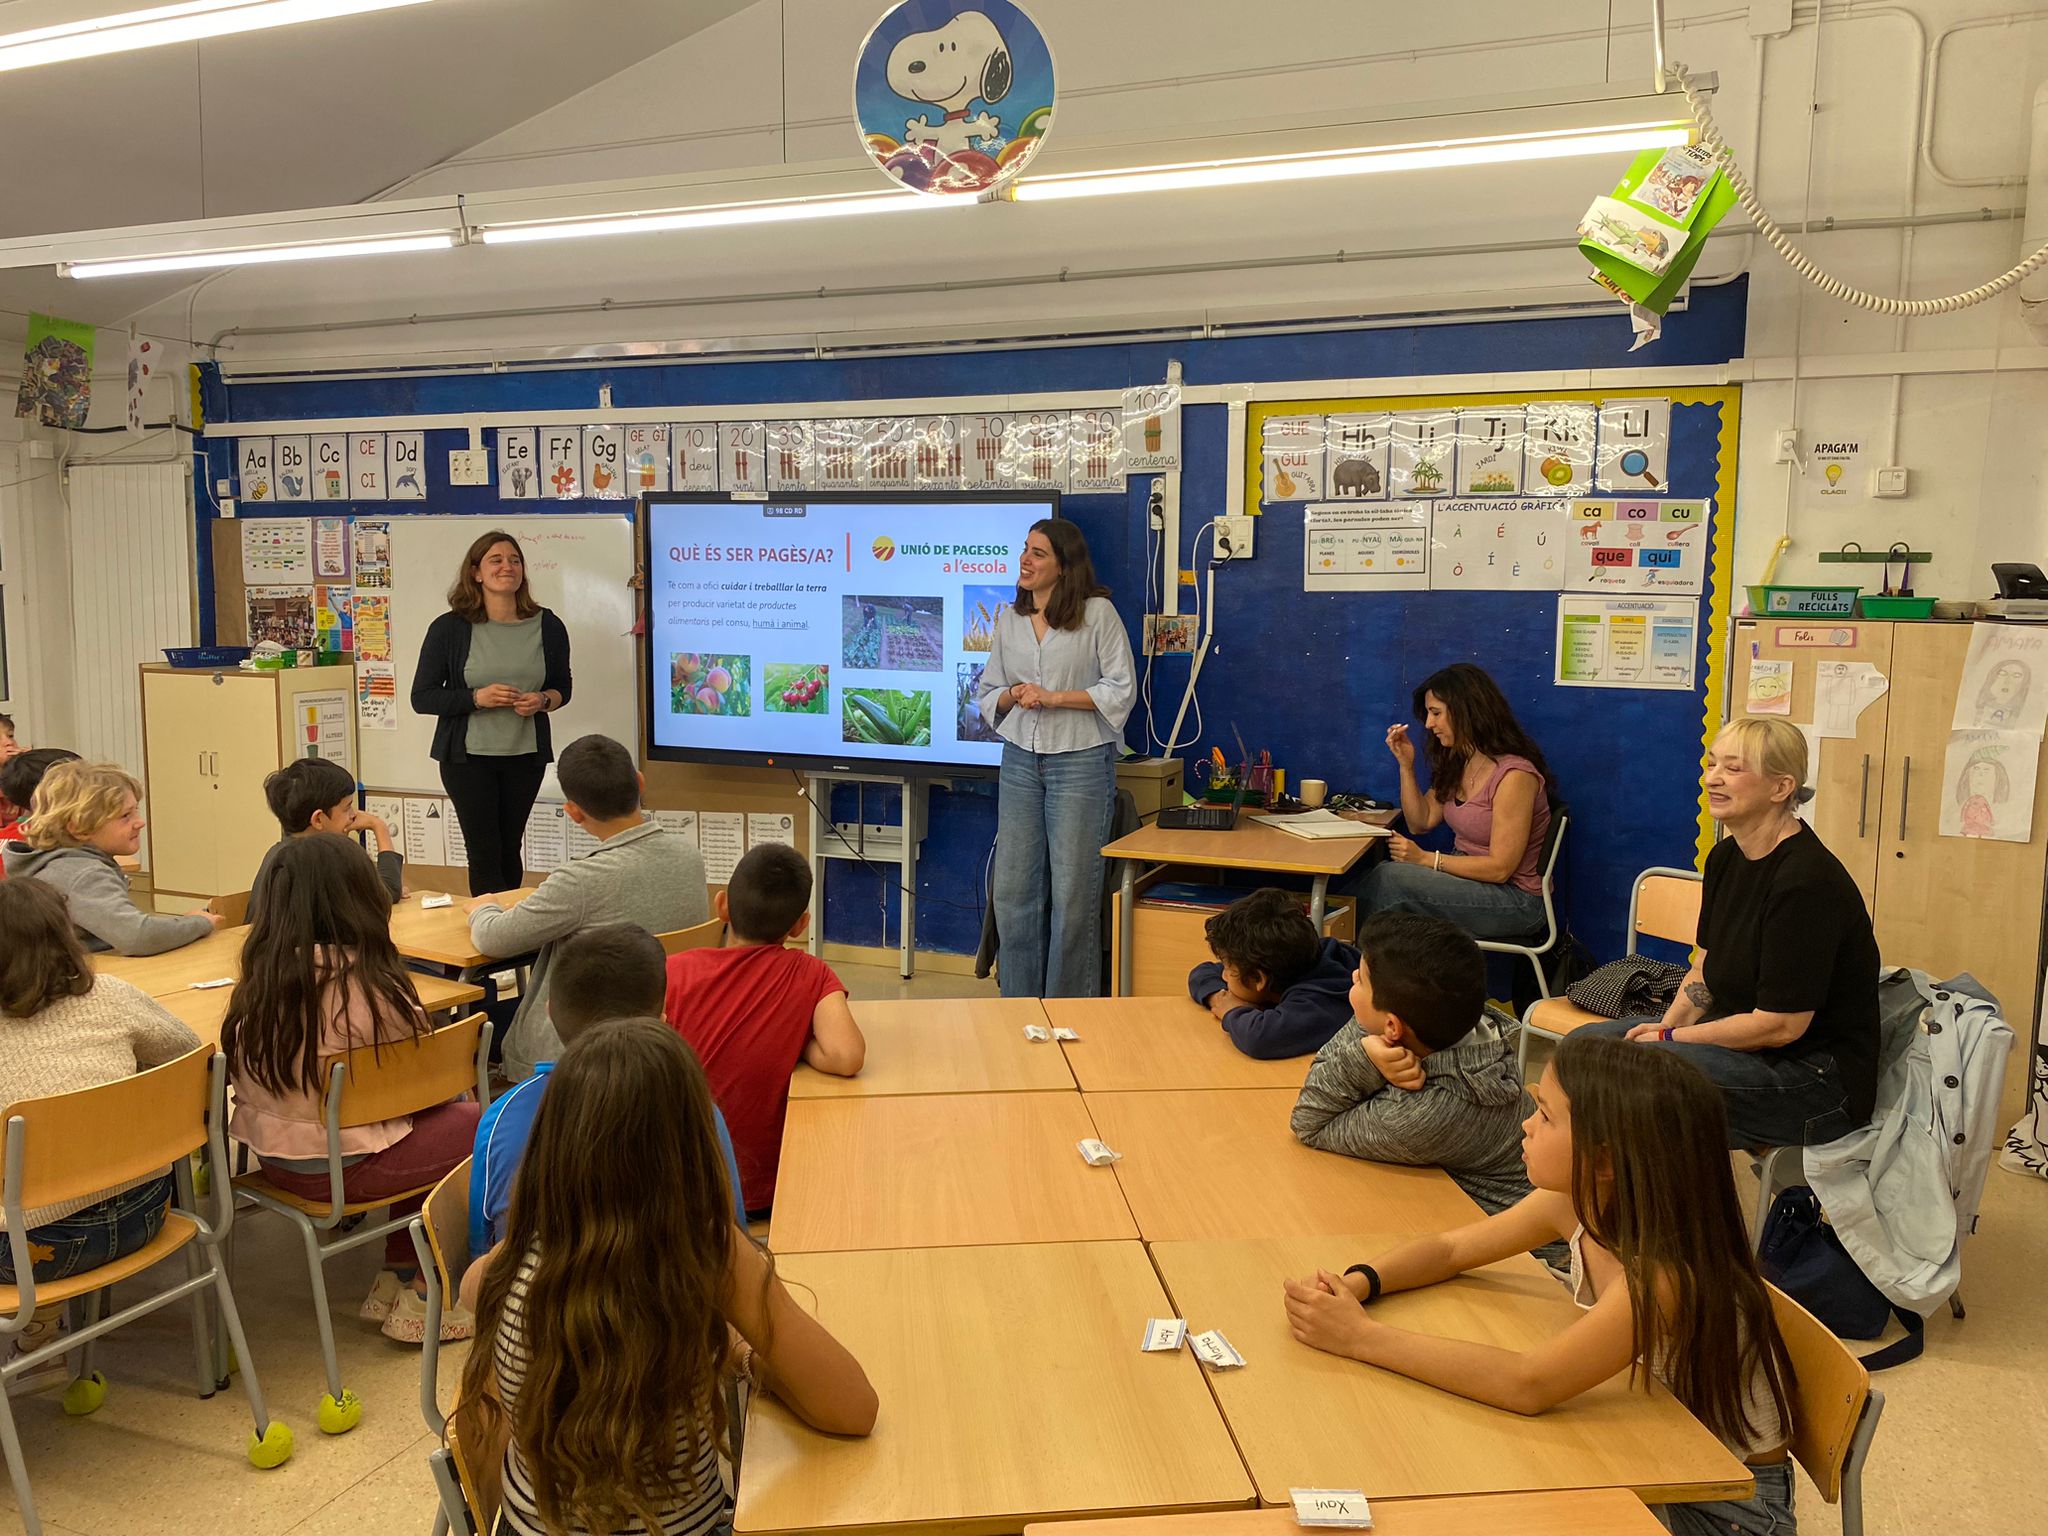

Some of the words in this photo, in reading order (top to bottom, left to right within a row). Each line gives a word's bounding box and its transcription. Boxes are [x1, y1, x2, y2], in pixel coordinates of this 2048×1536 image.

[1134, 391, 1171, 411] 100
[976, 417, 1004, 438] 70
[1030, 415, 1059, 436] 80
[1085, 411, 1115, 433] 90
[1281, 421, 1310, 436] GUE
[1543, 414, 1579, 441] Kk
[1623, 409, 1649, 438] Ll
[630, 429, 645, 442] GE
[652, 429, 666, 442] GI
[685, 429, 704, 448] 10
[731, 428, 754, 447] 20
[778, 425, 804, 446] 30
[877, 422, 904, 443] 50
[1342, 424, 1376, 450] Hh
[1478, 417, 1507, 453] Jj
[320, 442, 340, 463] Cc
[360, 439, 376, 455] CE
[396, 440, 417, 462] Dd
[506, 437, 528, 459] Ee
[550, 437, 573, 461] Ff
[592, 434, 617, 463] Gg
[1814, 443, 1858, 453] APAGA'M
[245, 448, 266, 469] Aa
[282, 446, 303, 467] Bb
[1128, 453, 1177, 467] centena
[1281, 453, 1308, 467] GUI
[689, 458, 711, 471] deu
[361, 473, 376, 488] CI
[821, 480, 859, 490] quaranta
[967, 479, 1012, 490] setanta
[1076, 476, 1121, 489] noranta
[1437, 500, 1517, 512] L'ACCENTUACIÓ
[1583, 507, 1602, 517] ca
[1628, 508, 1647, 518] co
[1671, 508, 1690, 519] cu
[1453, 524, 1462, 538] À
[1497, 523, 1505, 538] É
[1537, 531, 1546, 546] Ú
[669, 543, 700, 563] QUÈ
[705, 543, 721, 561] ÉS
[726, 547, 754, 562] SER
[758, 544, 834, 565] PAGÈS/A?
[901, 542, 931, 555] UNIÓ
[934, 545, 950, 555] DE
[953, 545, 1009, 556] PAGESOS
[1488, 552, 1495, 566] Í
[1595, 551, 1625, 565] que
[1647, 551, 1672, 566] qui
[943, 562, 951, 573] a
[954, 559, 1007, 573] l'escola
[1453, 562, 1463, 576] Ò
[1512, 561, 1520, 577] È
[674, 582, 695, 590] com
[703, 581, 719, 590] ofici
[721, 581, 747, 591] cuidar
[749, 582, 752, 591] i
[795, 583, 804, 592] la
[806, 584, 828, 592] terra
[1811, 592, 1839, 601] FULLS
[682, 600, 715, 609] producir
[716, 600, 746, 609] varietat
[747, 601, 758, 610] de
[758, 601, 797, 611] productes
[1617, 602, 1655, 610] ACCENTUACIÓ
[1798, 602, 1849, 612] RECICLATS
[712, 618, 724, 628] pel
[777, 620, 780, 628] i
[1315, 1499, 1350, 1515] Xavi
